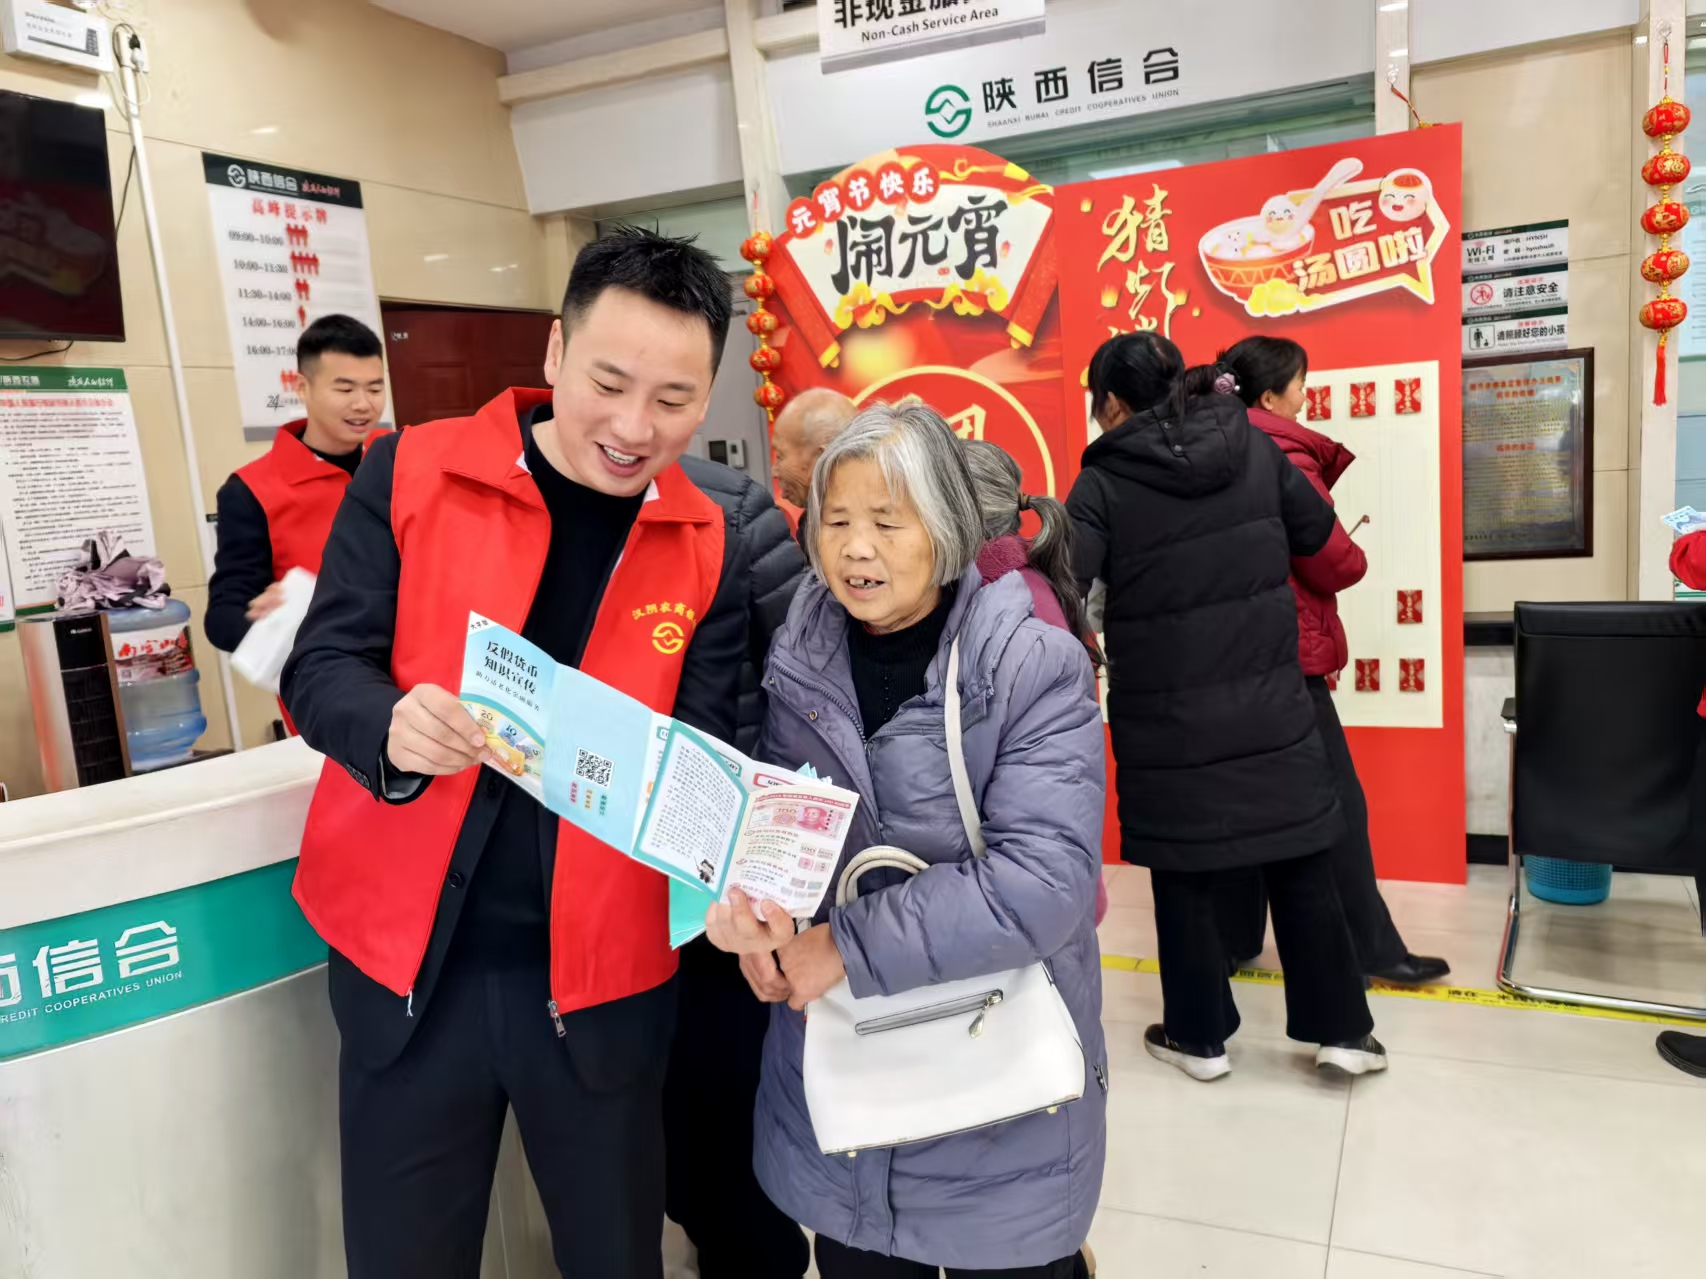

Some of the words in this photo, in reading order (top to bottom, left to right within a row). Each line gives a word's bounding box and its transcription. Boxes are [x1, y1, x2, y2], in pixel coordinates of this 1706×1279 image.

[861, 20, 920, 42] Non-Cash
[922, 13, 967, 31] Service
[970, 8, 999, 23] Area
[982, 47, 1180, 113] 陕西信合
[1055, 106, 1081, 116] CREDIT
[1087, 95, 1146, 110] COOPERATIVES
[1152, 89, 1179, 99] UNION
[246, 168, 298, 192] 陕西信合
[791, 168, 934, 234] 元宵节快乐
[1329, 200, 1377, 240] 吃
[831, 194, 1008, 295] 闹元宵
[1097, 183, 1176, 339] 猜灯
[1293, 227, 1428, 291] 汤圆啦
[1467, 245, 1495, 257] Wi-Fi
[1503, 282, 1559, 298] 请注意安全
[484, 655, 537, 695] 知识宣传
[486, 641, 538, 678] 反假货币
[480, 709, 494, 722] 20
[505, 724, 518, 737] 10
[44, 983, 141, 1014] COOPERATIVES
[146, 970, 183, 988] UNION
